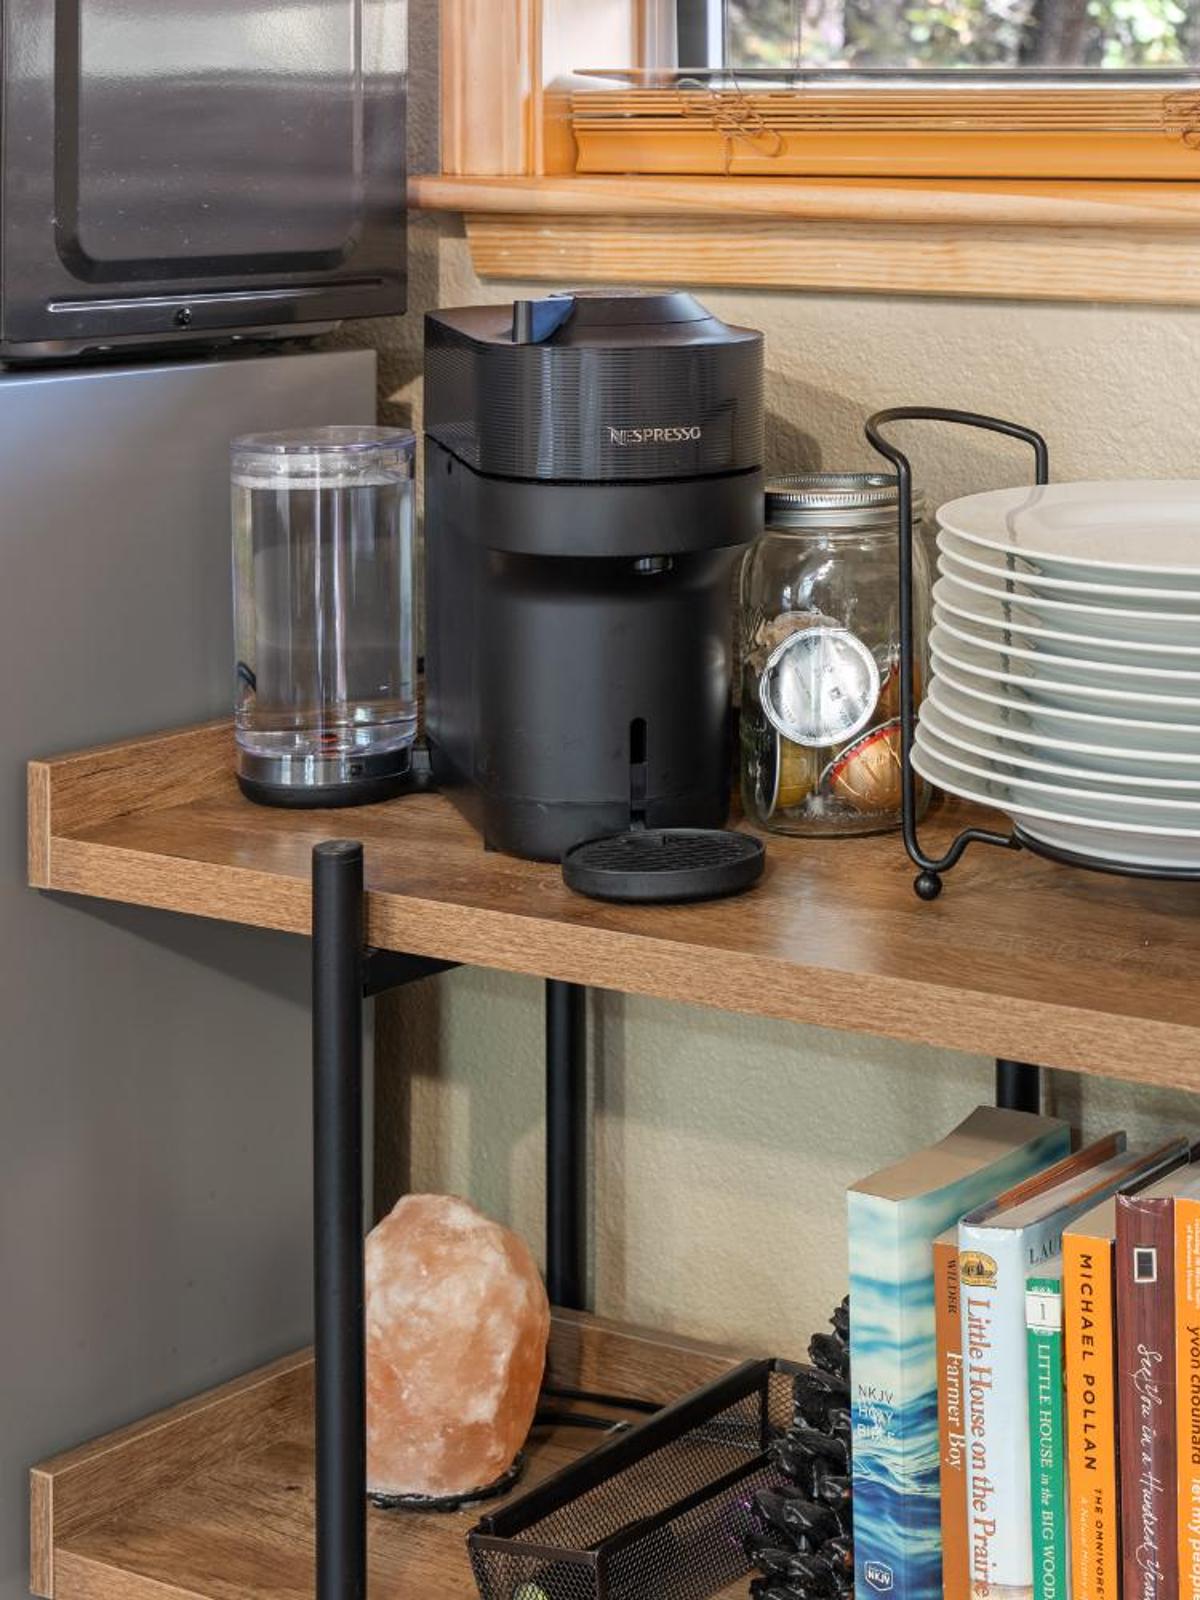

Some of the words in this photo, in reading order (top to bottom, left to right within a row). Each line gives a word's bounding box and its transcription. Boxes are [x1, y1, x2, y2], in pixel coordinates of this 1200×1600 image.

[606, 426, 702, 446] NESPRESSO
[947, 1259, 957, 1314] WILDER
[1079, 1253, 1094, 1361] MICHAEL
[967, 1297, 991, 1359] Little
[1186, 1325, 1200, 1369] yvon
[858, 1384, 894, 1404] NKJV
[946, 1351, 963, 1427] Farmer
[1038, 1344, 1051, 1404] LITTLE
[969, 1363, 992, 1438] House
[1082, 1374, 1097, 1471] POLLAN
[944, 1431, 966, 1471] Boy
[970, 1441, 986, 1470] on
[1039, 1410, 1053, 1468] HOUSE
[1140, 1425, 1157, 1446] in
[1040, 1473, 1051, 1485] in
[1141, 1451, 1152, 1466] a
[972, 1475, 994, 1512] the
[1041, 1487, 1053, 1506] the
[1094, 1488, 1103, 1514] THE
[1139, 1471, 1165, 1551] Hundred
[1041, 1510, 1054, 1540] BIG
[973, 1517, 997, 1598] Prairie
[1042, 1545, 1056, 1600] WOOD
